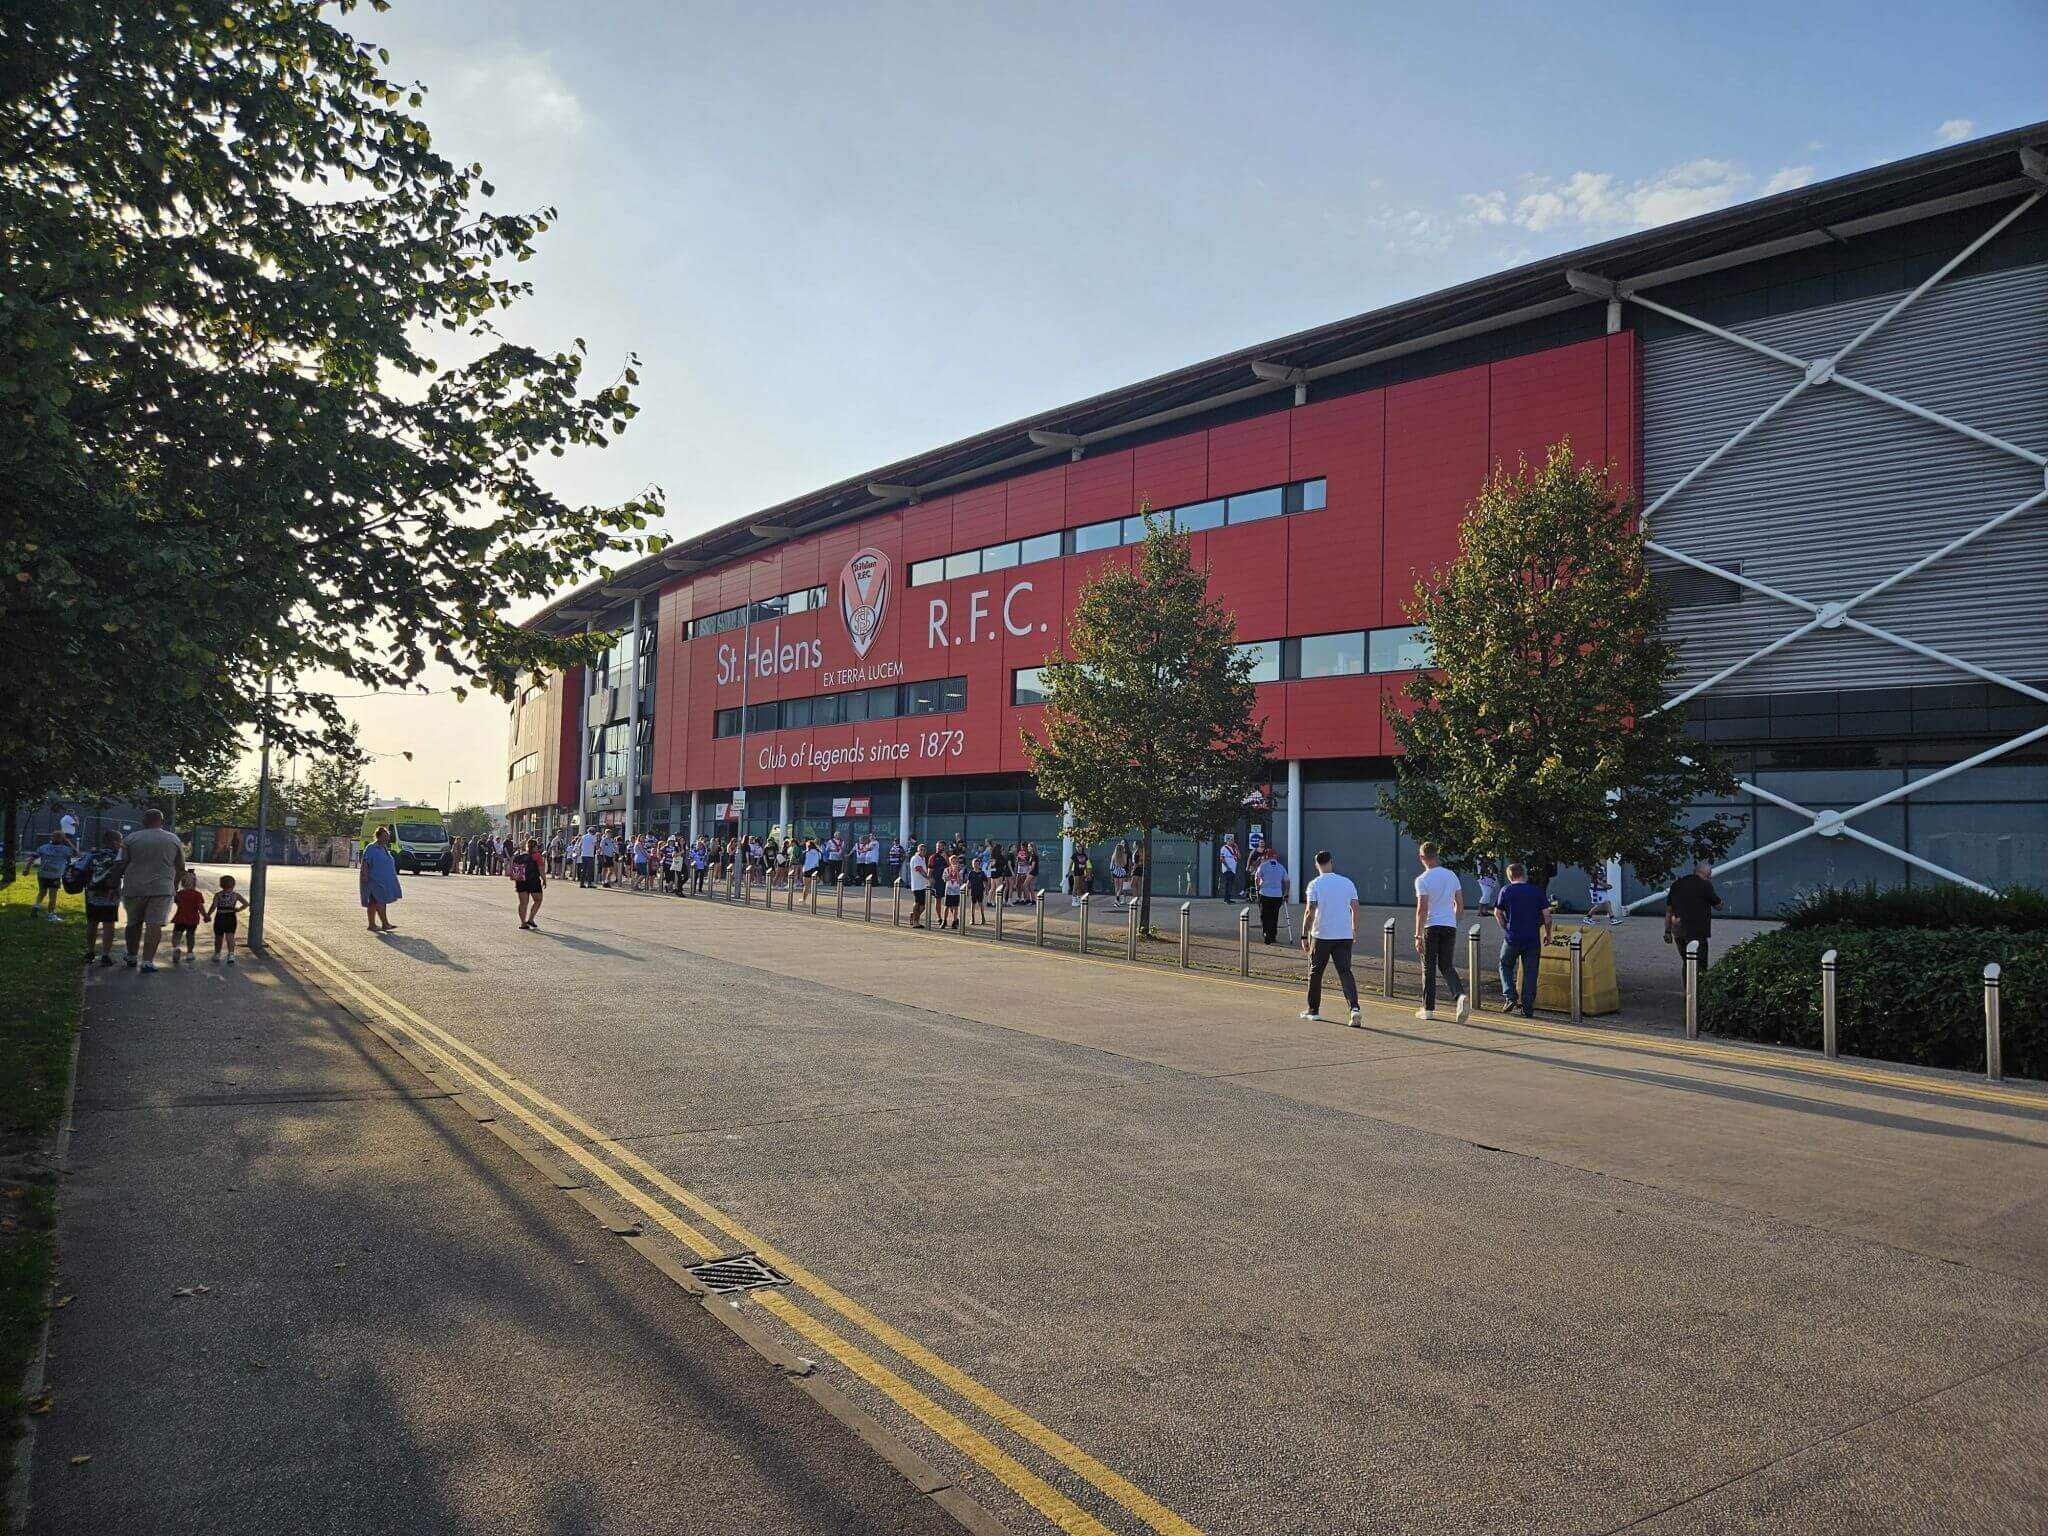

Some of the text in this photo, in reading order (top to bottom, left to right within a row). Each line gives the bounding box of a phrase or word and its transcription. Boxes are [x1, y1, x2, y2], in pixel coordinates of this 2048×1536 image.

[717, 581, 1048, 685] St. Helens R.F.C.
[823, 661, 904, 687] EX TERRA LUCEM
[759, 730, 965, 772] Club of Legends since 1873
